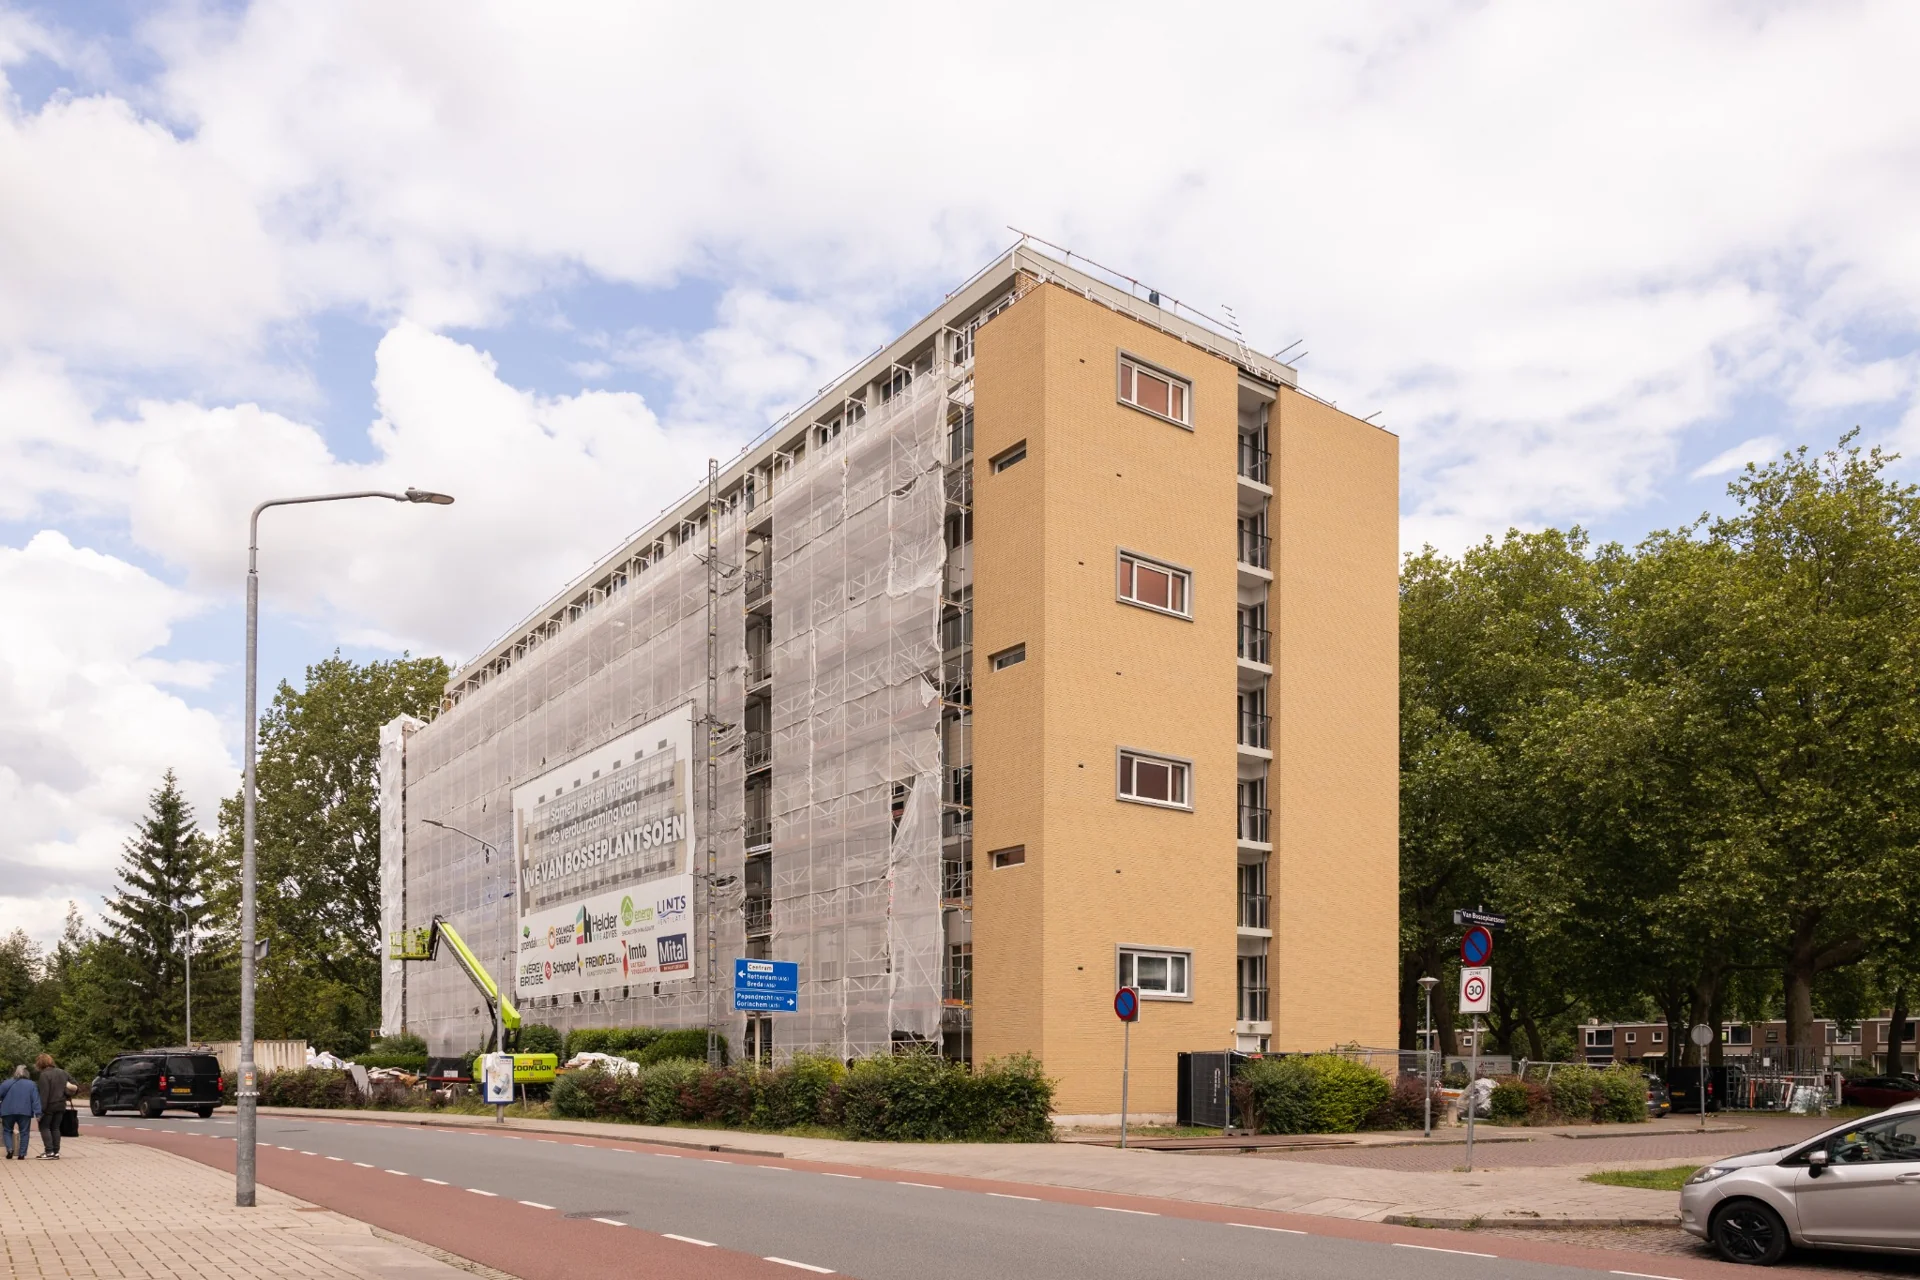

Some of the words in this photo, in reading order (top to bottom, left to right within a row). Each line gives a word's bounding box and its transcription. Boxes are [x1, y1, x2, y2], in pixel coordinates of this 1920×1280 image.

[551, 801, 576, 821] Samen
[577, 788, 605, 809] werken
[606, 777, 618, 801] wij
[619, 774, 637, 793] aan
[551, 828, 560, 845] de
[560, 806, 619, 841] verduurzaming
[620, 800, 637, 818] van
[540, 855, 564, 883] VAN
[565, 812, 686, 876] BOSSEPLANTSOEN
[656, 895, 686, 914] LINTS
[592, 911, 617, 933] Helder
[628, 943, 647, 960] Imto
[658, 937, 687, 963] Mital
[553, 960, 576, 974] Schipper
[747, 973, 778, 981] Rotterdam
[736, 992, 774, 1001] Papendrecht
[1468, 985, 1482, 996] 30
[736, 1000, 768, 1008] Gorinchem
